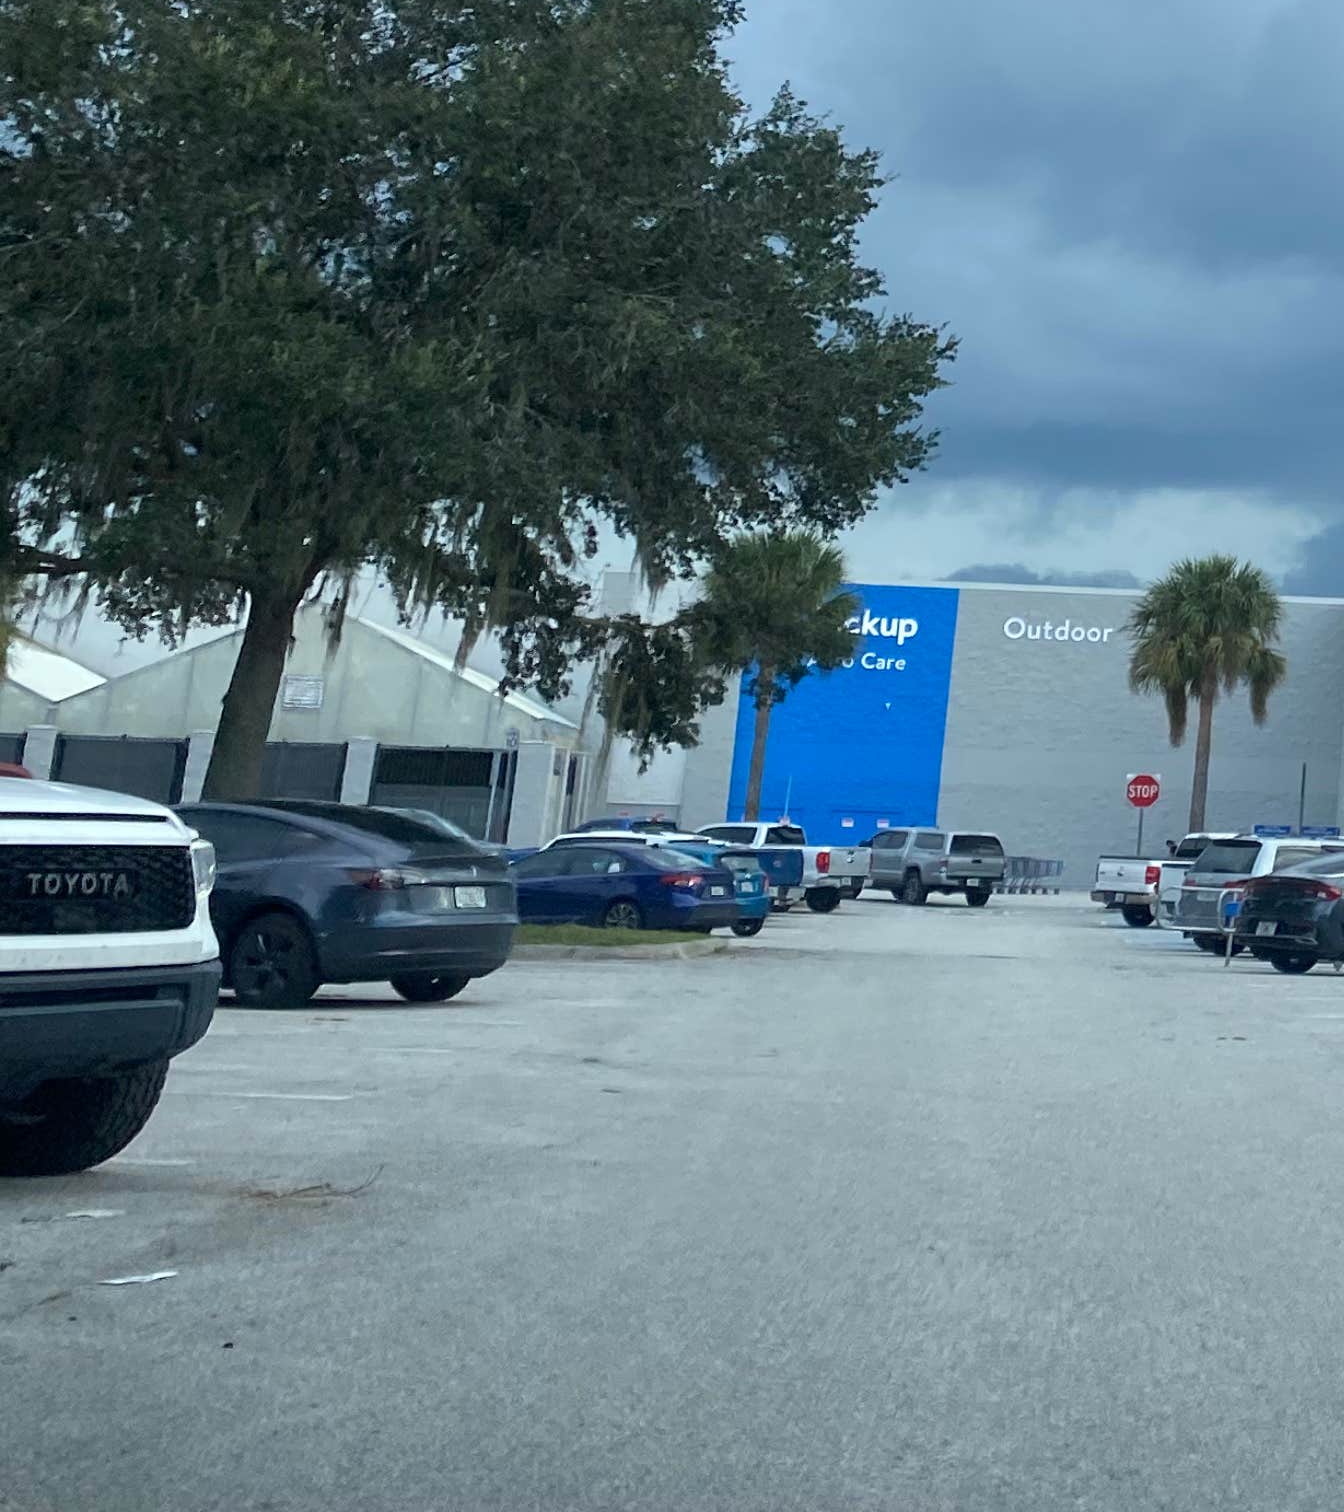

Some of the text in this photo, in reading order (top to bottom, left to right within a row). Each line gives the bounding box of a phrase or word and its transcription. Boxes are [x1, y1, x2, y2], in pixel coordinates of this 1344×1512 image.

[843, 608, 919, 646] ckup
[1003, 616, 1113, 643] Outdoor
[860, 651, 907, 671] Care
[1128, 784, 1158, 799] STOP
[27, 872, 130, 901] TOYOTA
